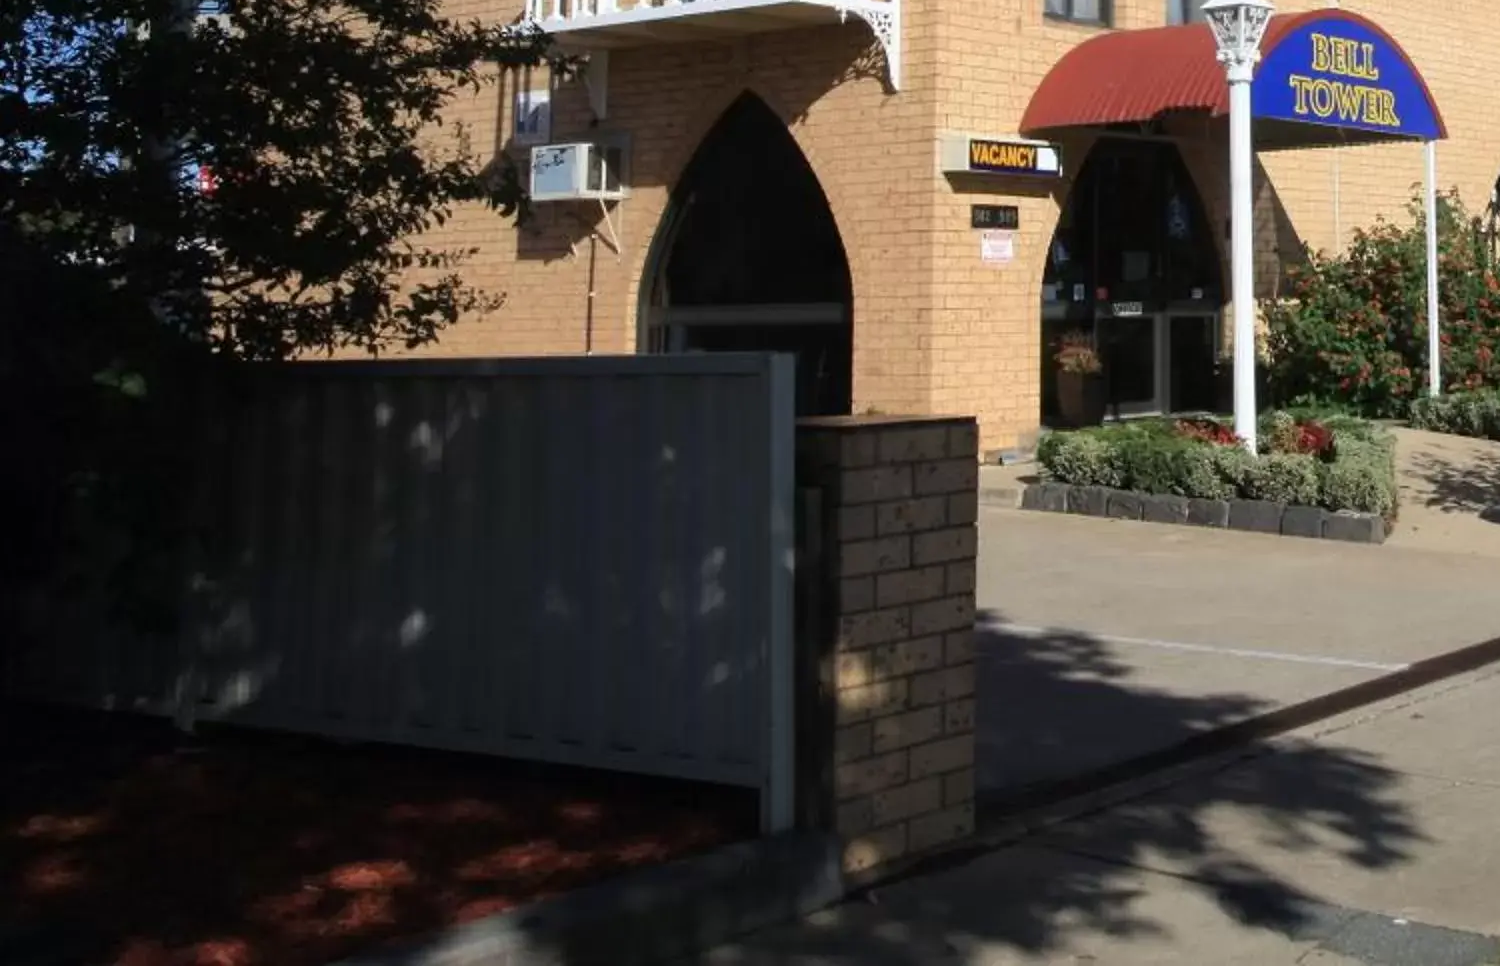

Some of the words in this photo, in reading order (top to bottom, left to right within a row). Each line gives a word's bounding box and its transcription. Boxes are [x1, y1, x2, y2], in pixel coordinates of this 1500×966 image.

[1311, 32, 1379, 80] BELL
[1289, 74, 1401, 127] TOWER
[971, 142, 1036, 168] VACANCY
